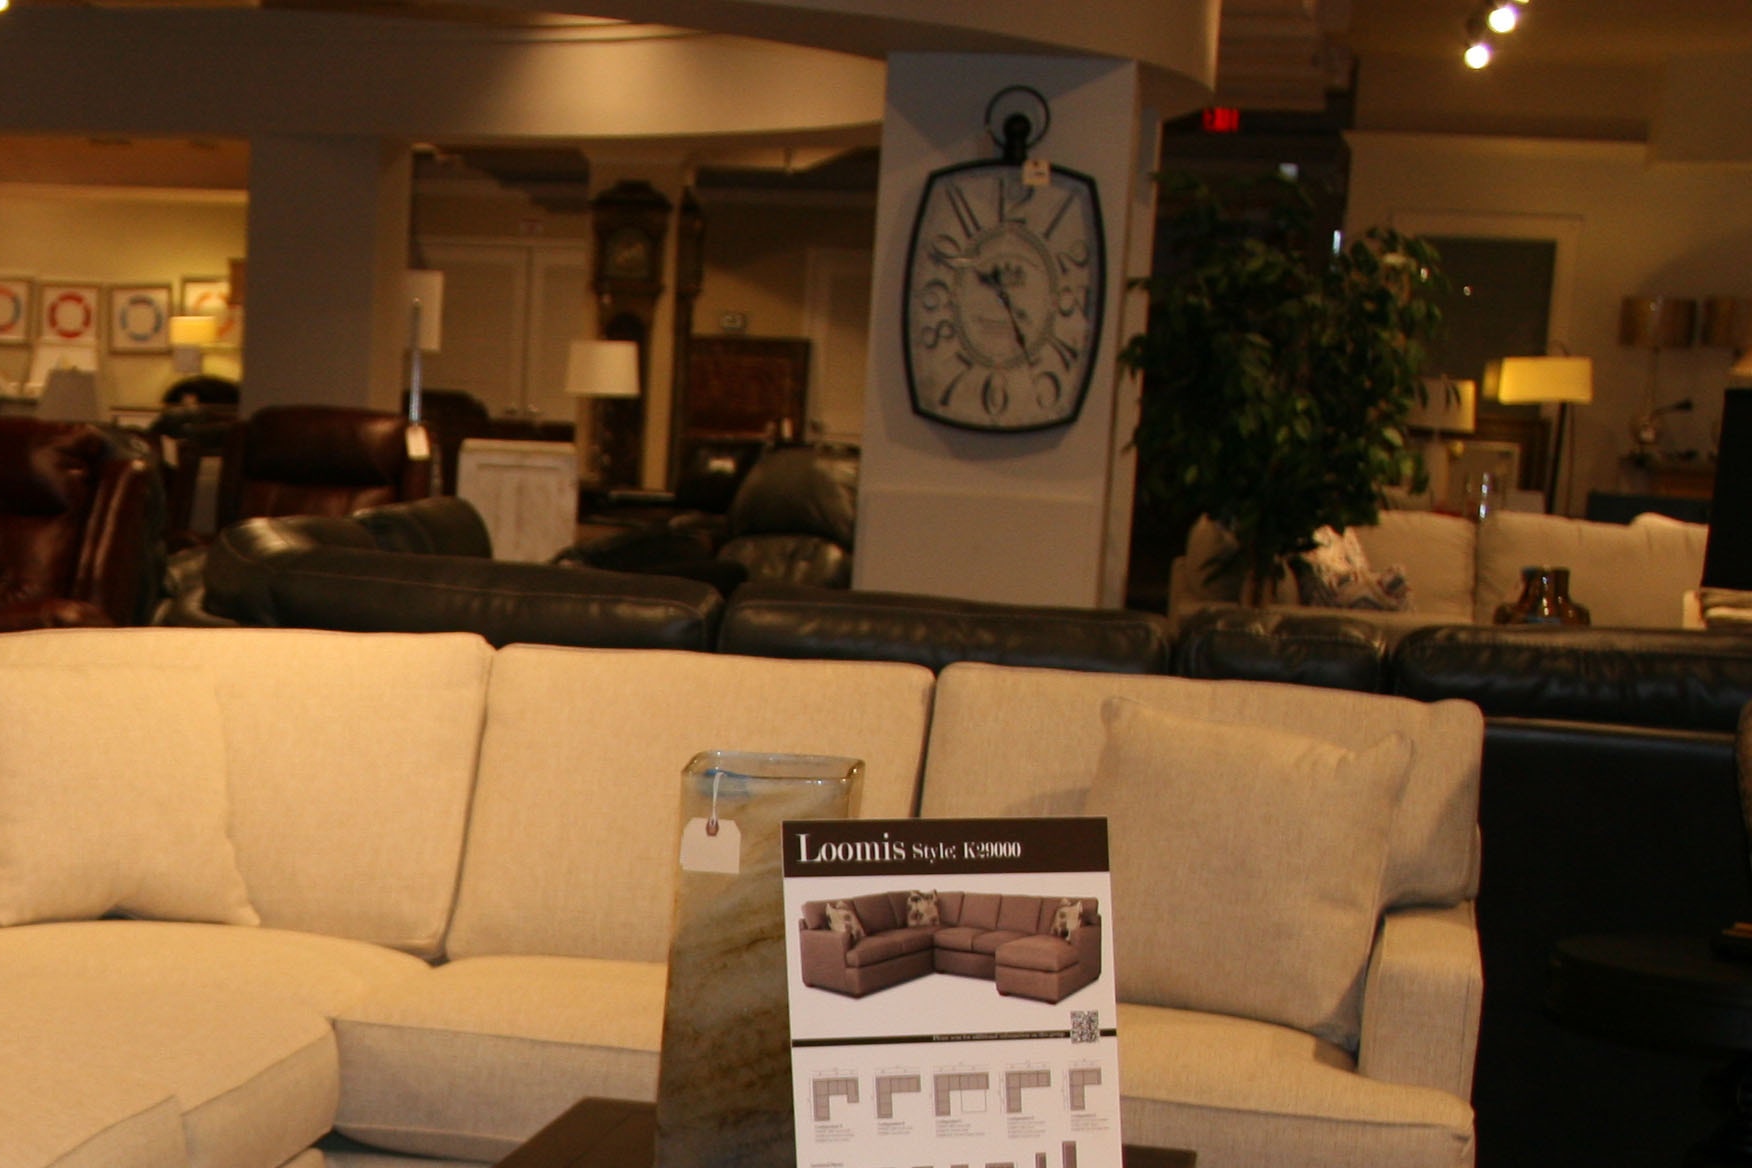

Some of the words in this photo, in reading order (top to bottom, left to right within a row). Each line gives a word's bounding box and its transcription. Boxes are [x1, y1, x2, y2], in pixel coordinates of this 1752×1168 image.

[922, 319, 958, 349] 8
[796, 833, 906, 863] Loomis
[963, 841, 1022, 859] K29000
